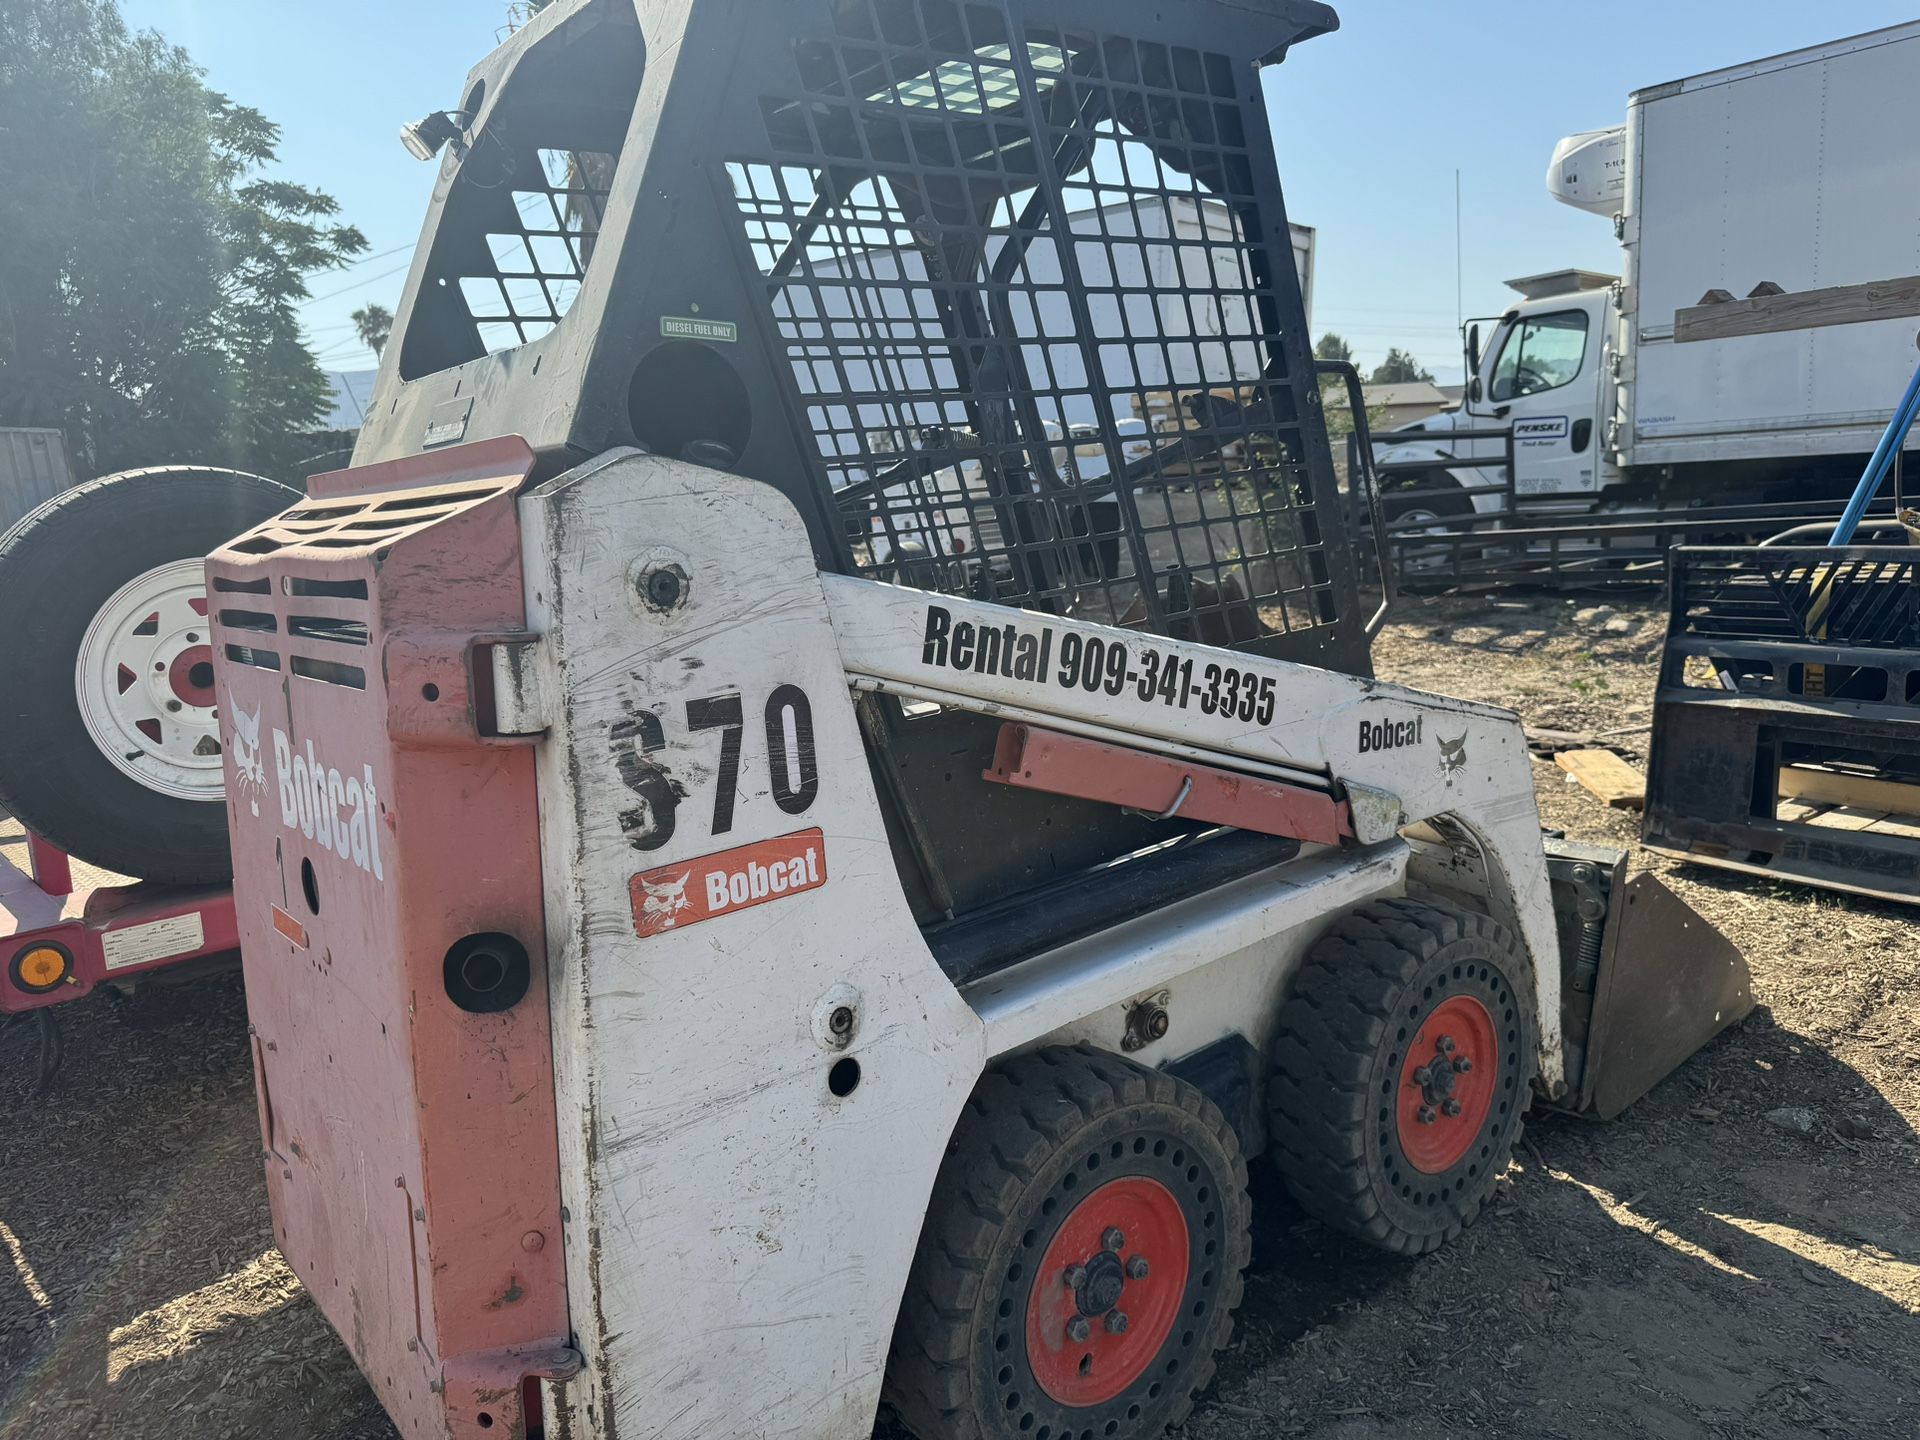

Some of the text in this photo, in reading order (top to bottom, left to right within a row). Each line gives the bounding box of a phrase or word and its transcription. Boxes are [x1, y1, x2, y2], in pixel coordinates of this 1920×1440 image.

[666, 321, 731, 337] DIESEL FUEL ONLY
[1516, 423, 1563, 433] PENSKE
[921, 605, 1277, 726] Rental 909-341-3335
[1359, 714, 1423, 753] Bobcat
[608, 684, 819, 851] S70
[272, 727, 384, 881] Bobcat
[705, 847, 819, 911] Bobcat
